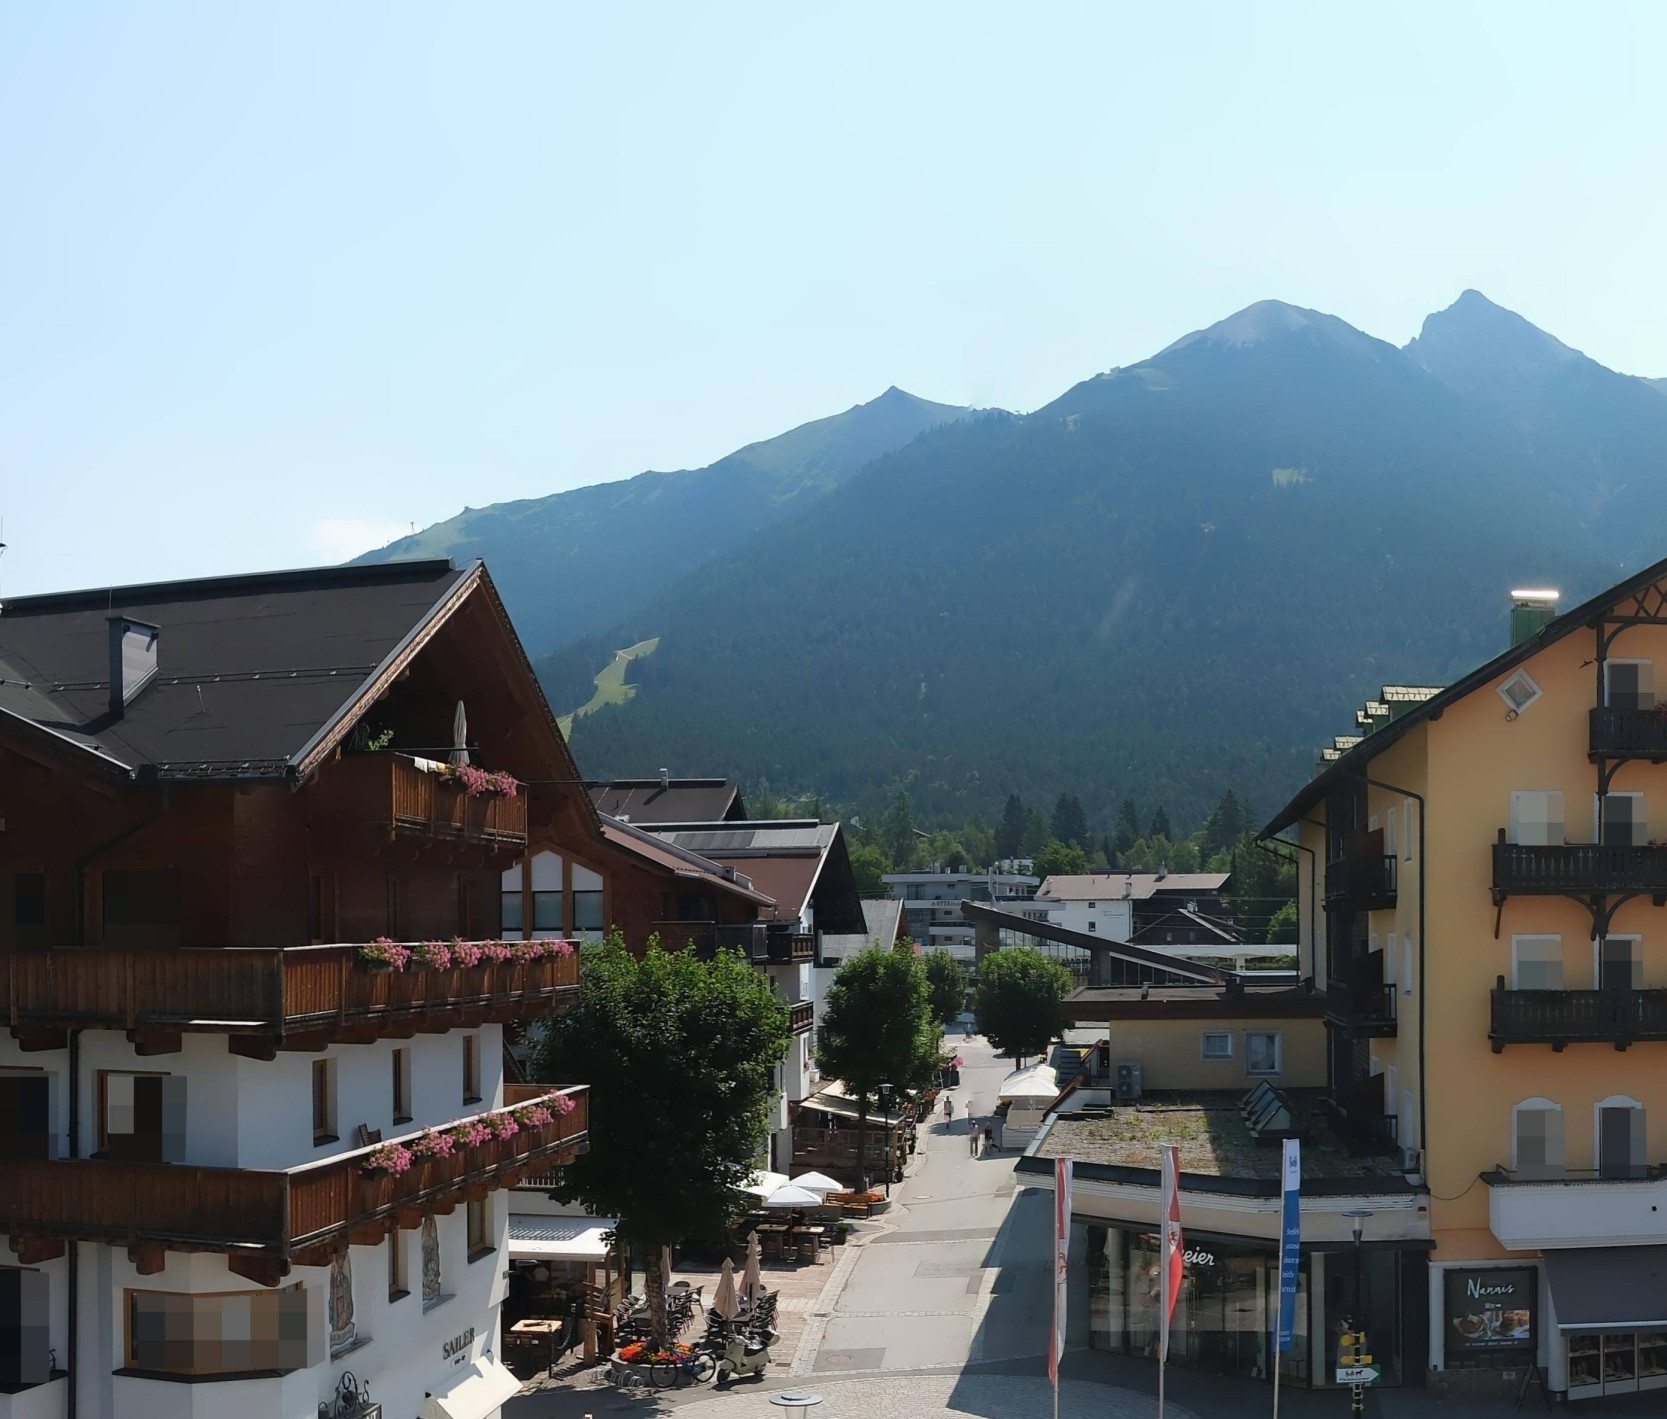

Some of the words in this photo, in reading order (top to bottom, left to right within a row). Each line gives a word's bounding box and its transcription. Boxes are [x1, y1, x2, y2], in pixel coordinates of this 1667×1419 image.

[1182, 1246, 1215, 1266] eier
[1467, 1277, 1515, 1299] Nannis
[443, 1327, 475, 1360] SAILER
